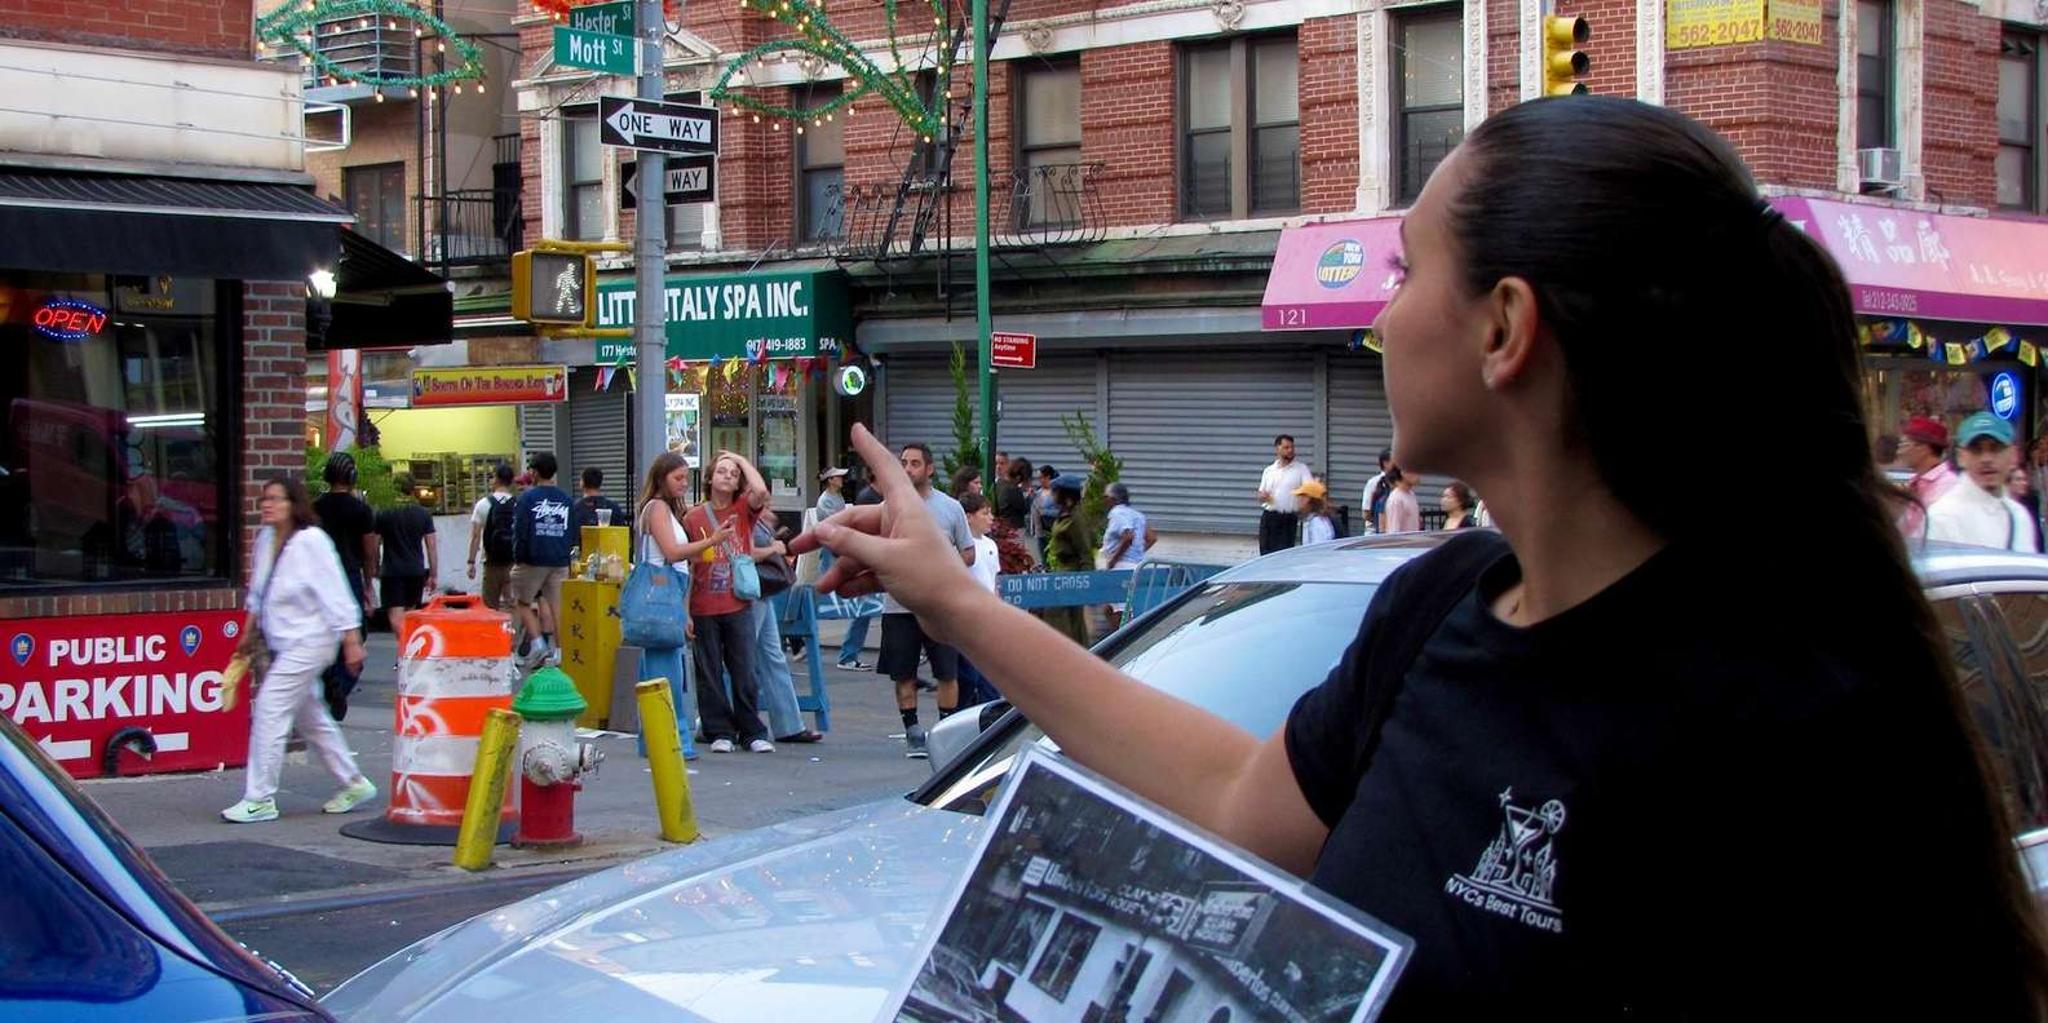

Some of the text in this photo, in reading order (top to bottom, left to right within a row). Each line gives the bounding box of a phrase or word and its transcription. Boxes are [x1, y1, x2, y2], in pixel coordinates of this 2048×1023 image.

[575, 5, 631, 34] Hester St
[1680, 18, 1760, 43] 562-2047
[569, 34, 623, 66] Mott St
[619, 113, 704, 139] ONE WAY
[671, 170, 701, 190] WAY
[1344, 243, 1361, 253] NEW
[1318, 265, 1361, 283] LOTTERY
[598, 290, 636, 325] LITT
[723, 283, 763, 320] SPA
[766, 281, 808, 318] INC.
[34, 307, 107, 334] OPEN
[1278, 309, 1306, 325] 121
[1008, 575, 1090, 593] DO NOT CROSS
[49, 634, 167, 667] PUBLIC
[1444, 877, 1563, 933] NYCs Best Tours
